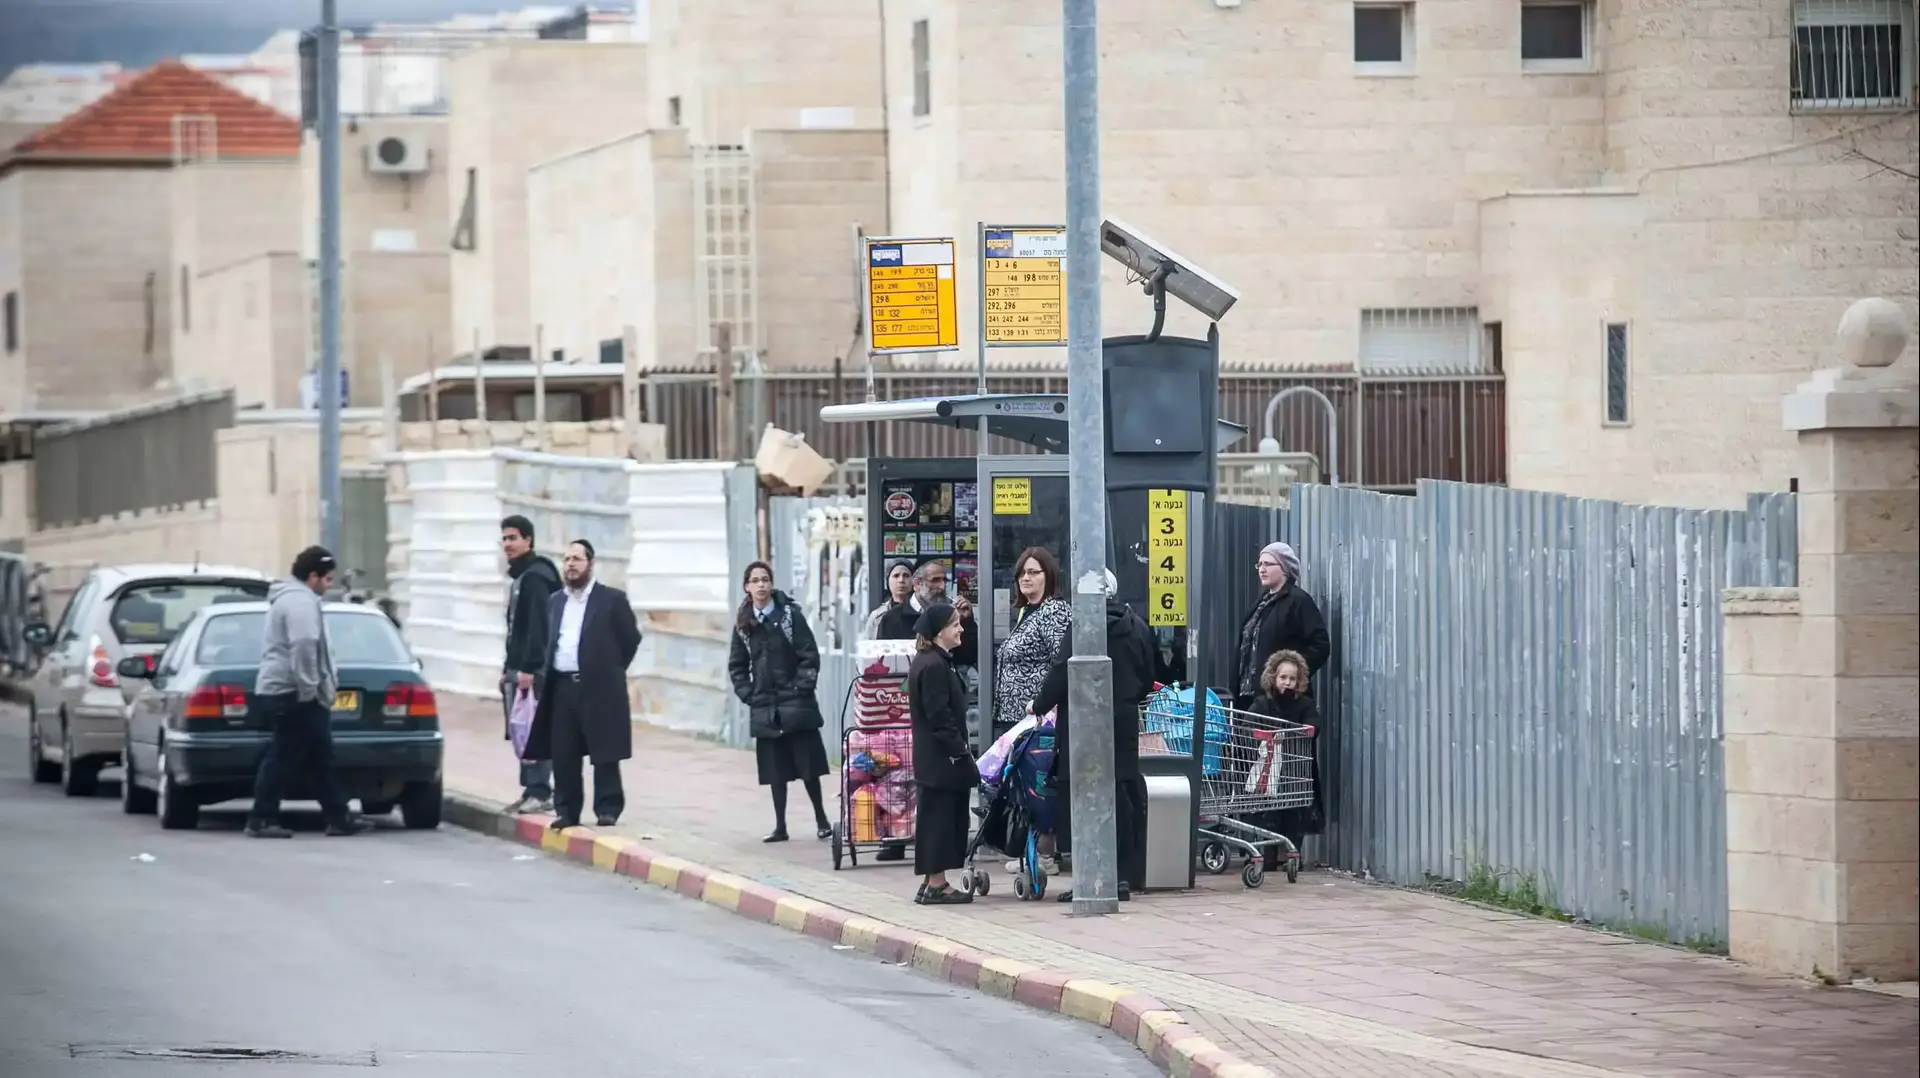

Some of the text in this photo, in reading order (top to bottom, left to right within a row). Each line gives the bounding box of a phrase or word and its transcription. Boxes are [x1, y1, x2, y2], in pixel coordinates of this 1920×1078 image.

[987, 260, 990, 268] 1
[996, 260, 1000, 268] 3
[1012, 261, 1017, 269] 6
[1024, 274, 1036, 282] 198
[988, 288, 1000, 296] 297
[1164, 500, 1183, 509] גבעה
[1161, 518, 1174, 535] 3
[1163, 538, 1183, 547] גבעה
[1160, 556, 1175, 572] 4
[1163, 575, 1184, 584] גבעה
[1161, 593, 1174, 610] 6
